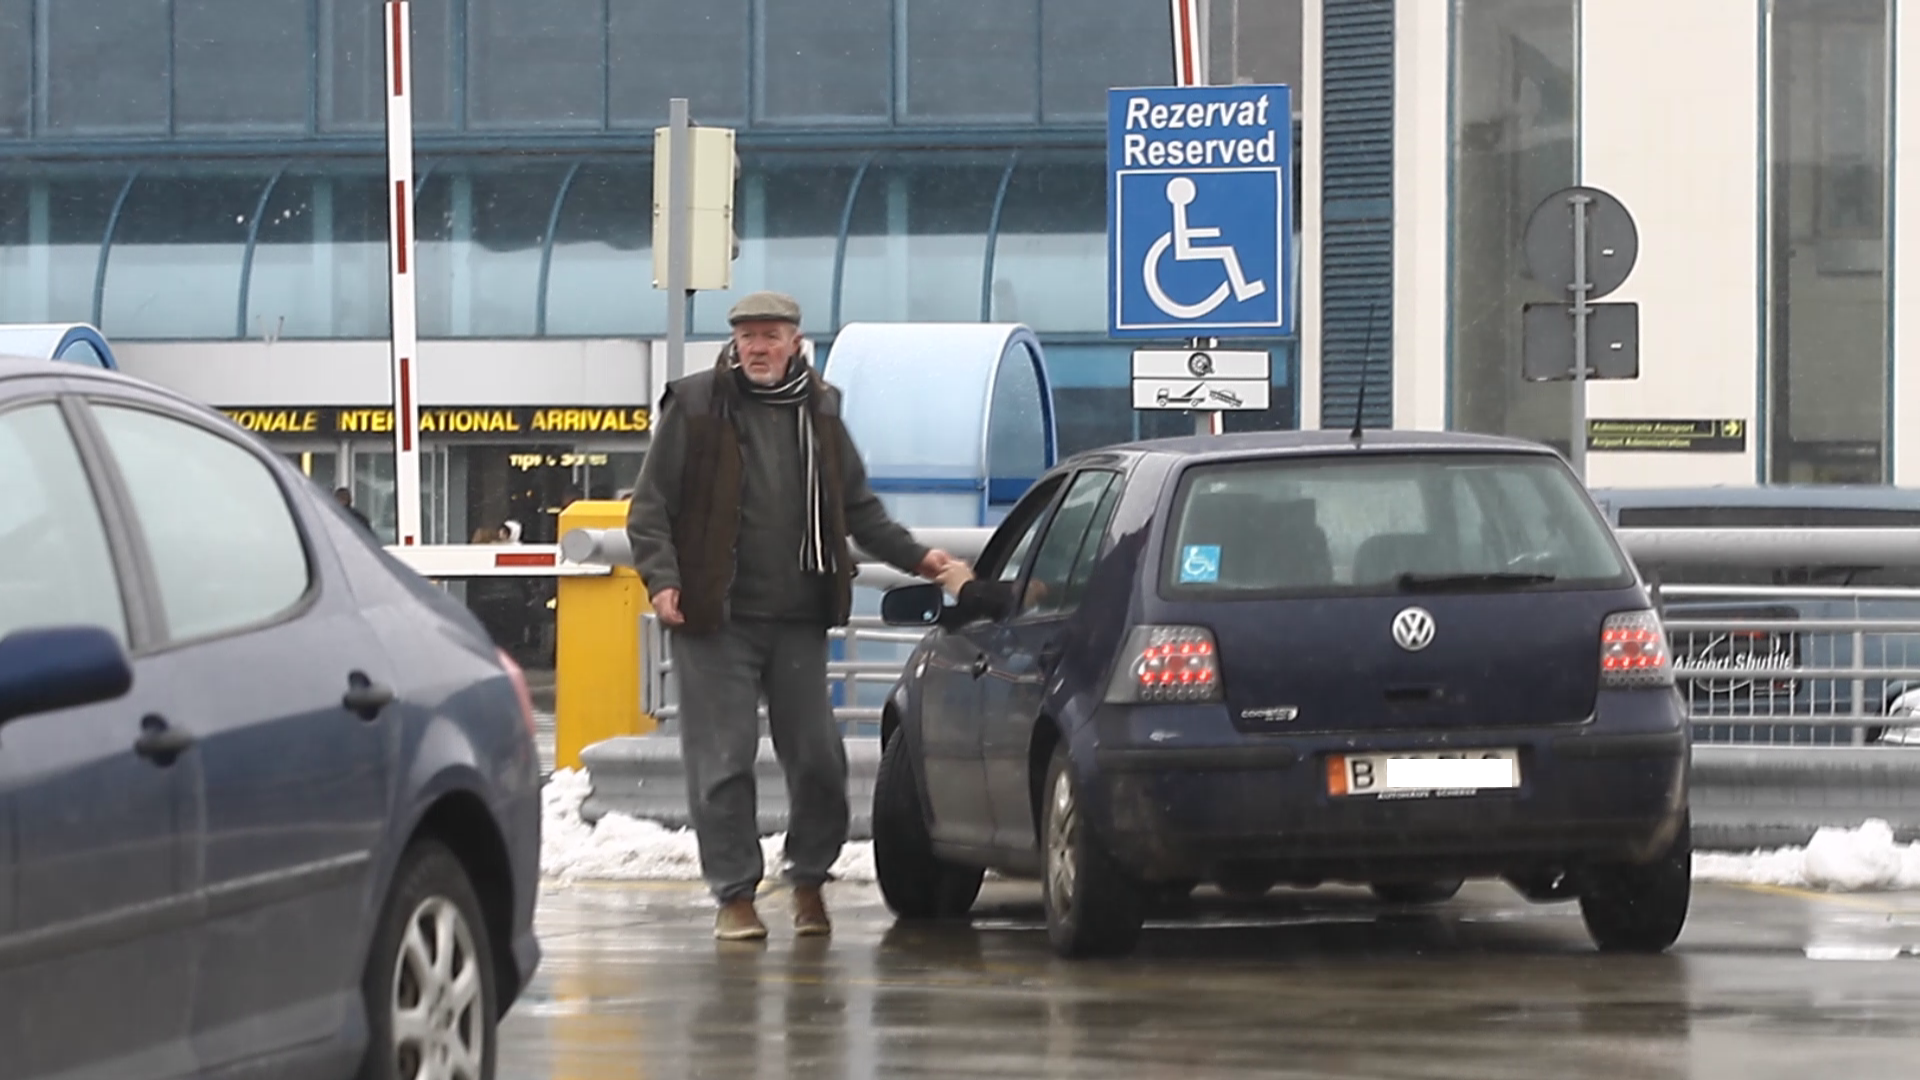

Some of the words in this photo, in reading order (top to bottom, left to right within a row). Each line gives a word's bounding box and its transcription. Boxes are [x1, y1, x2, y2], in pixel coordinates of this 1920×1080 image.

[1125, 94, 1269, 130] Rezervat
[1124, 130, 1276, 166] Reserved
[530, 409, 648, 431] ARRIVALS
[1351, 760, 1374, 789] B
